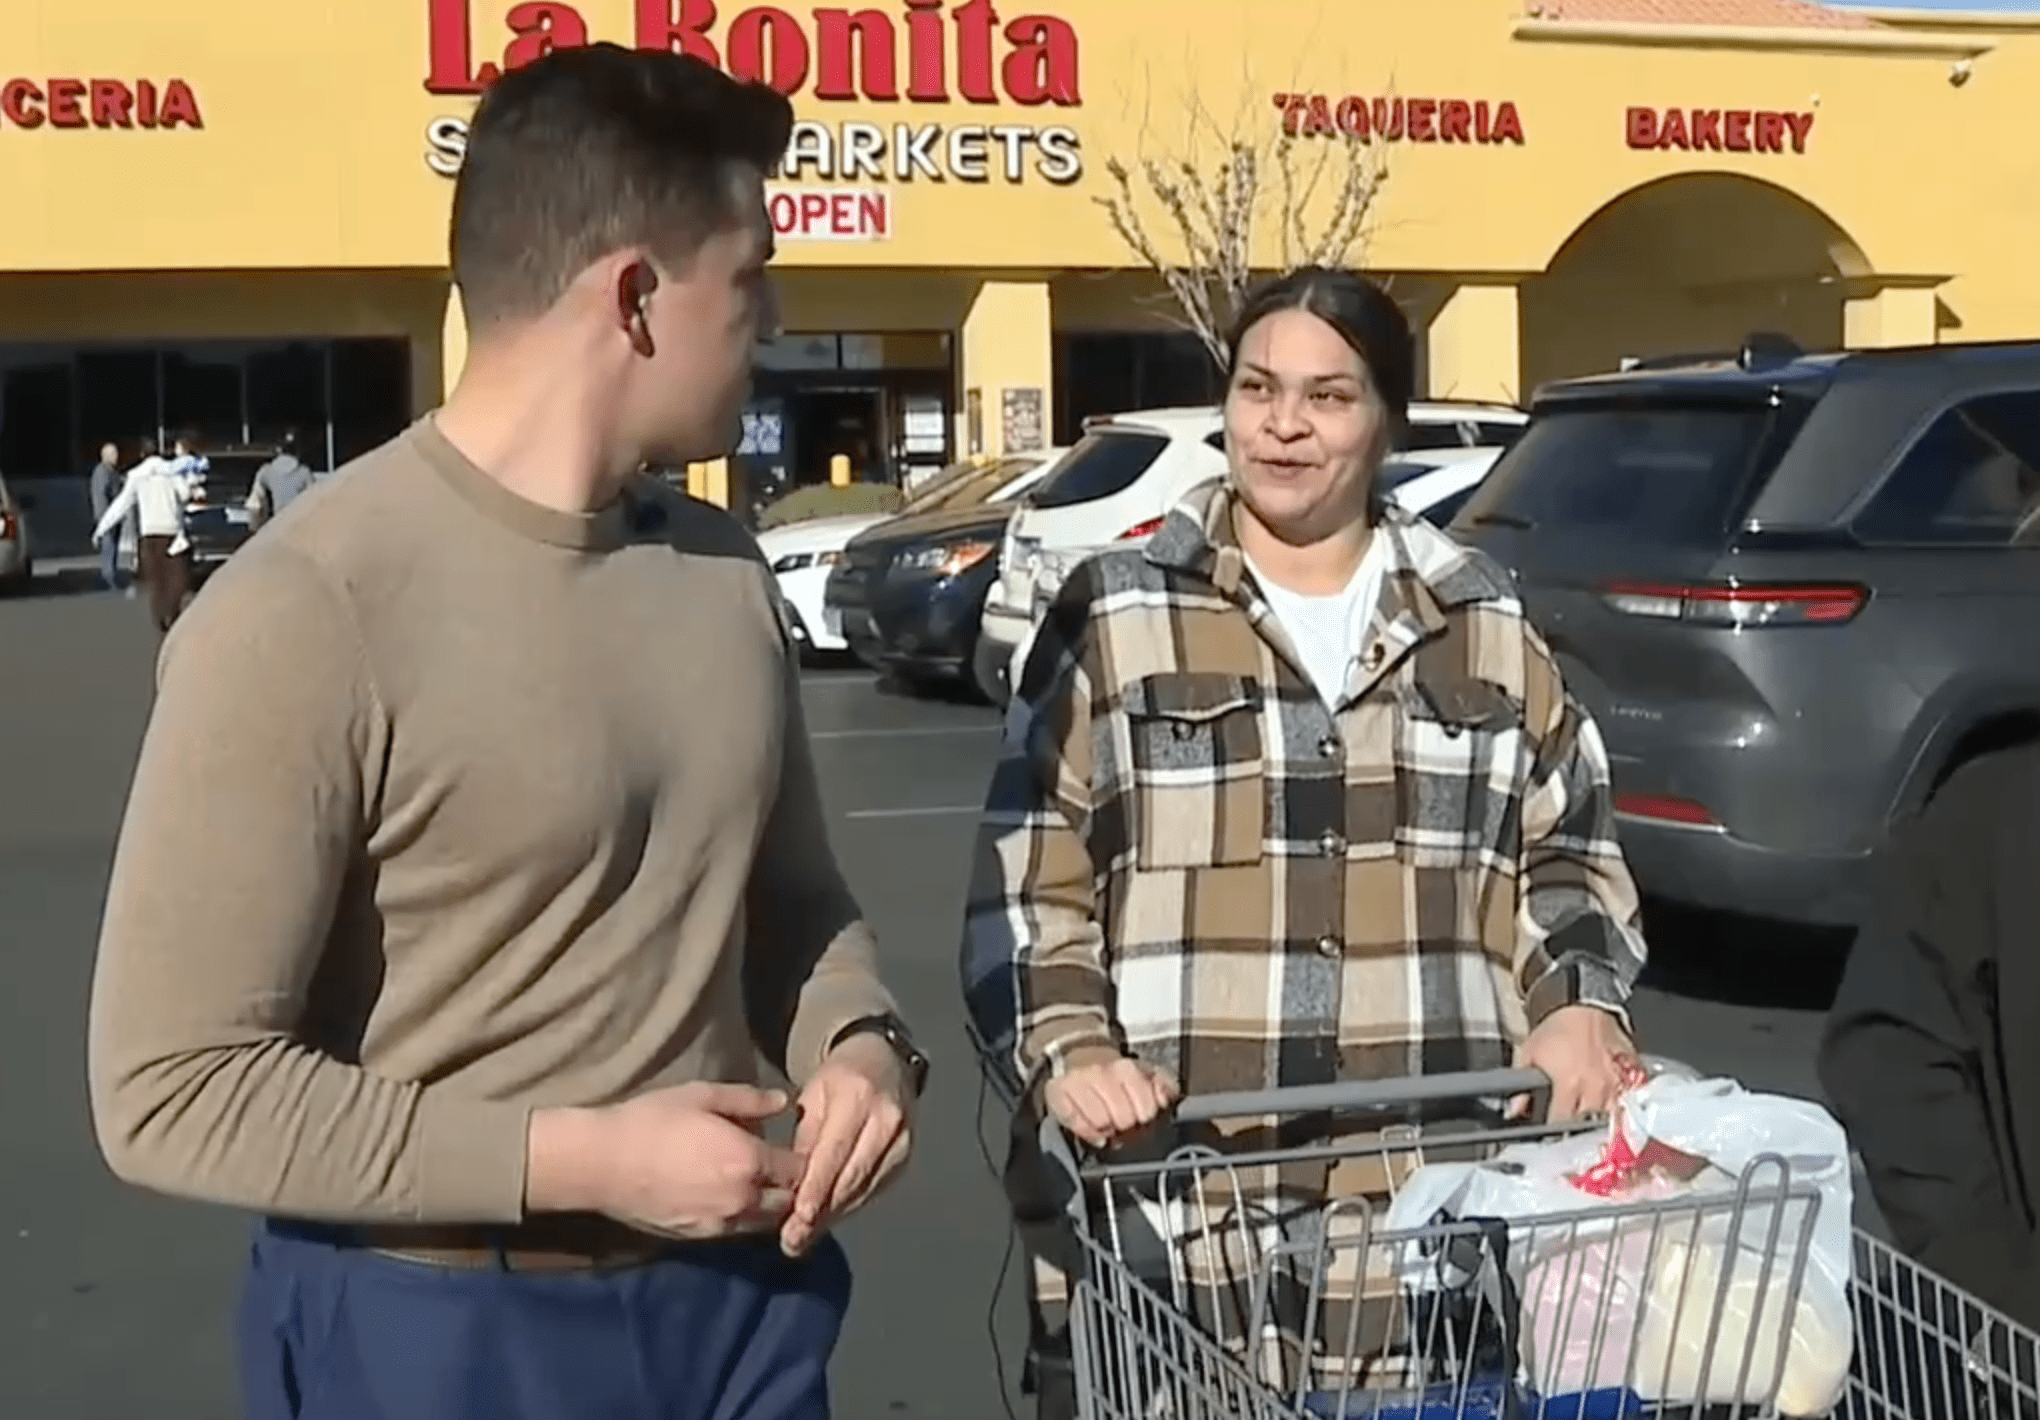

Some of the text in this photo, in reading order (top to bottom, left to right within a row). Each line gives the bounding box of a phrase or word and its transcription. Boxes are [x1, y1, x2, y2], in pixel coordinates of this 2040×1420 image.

[423, 0, 1083, 107] La Bonita
[0, 77, 205, 130] CERIA
[1272, 92, 1525, 146] TAQUERIA
[1625, 106, 1815, 155] BAKERY
[769, 193, 886, 235] OPEN
